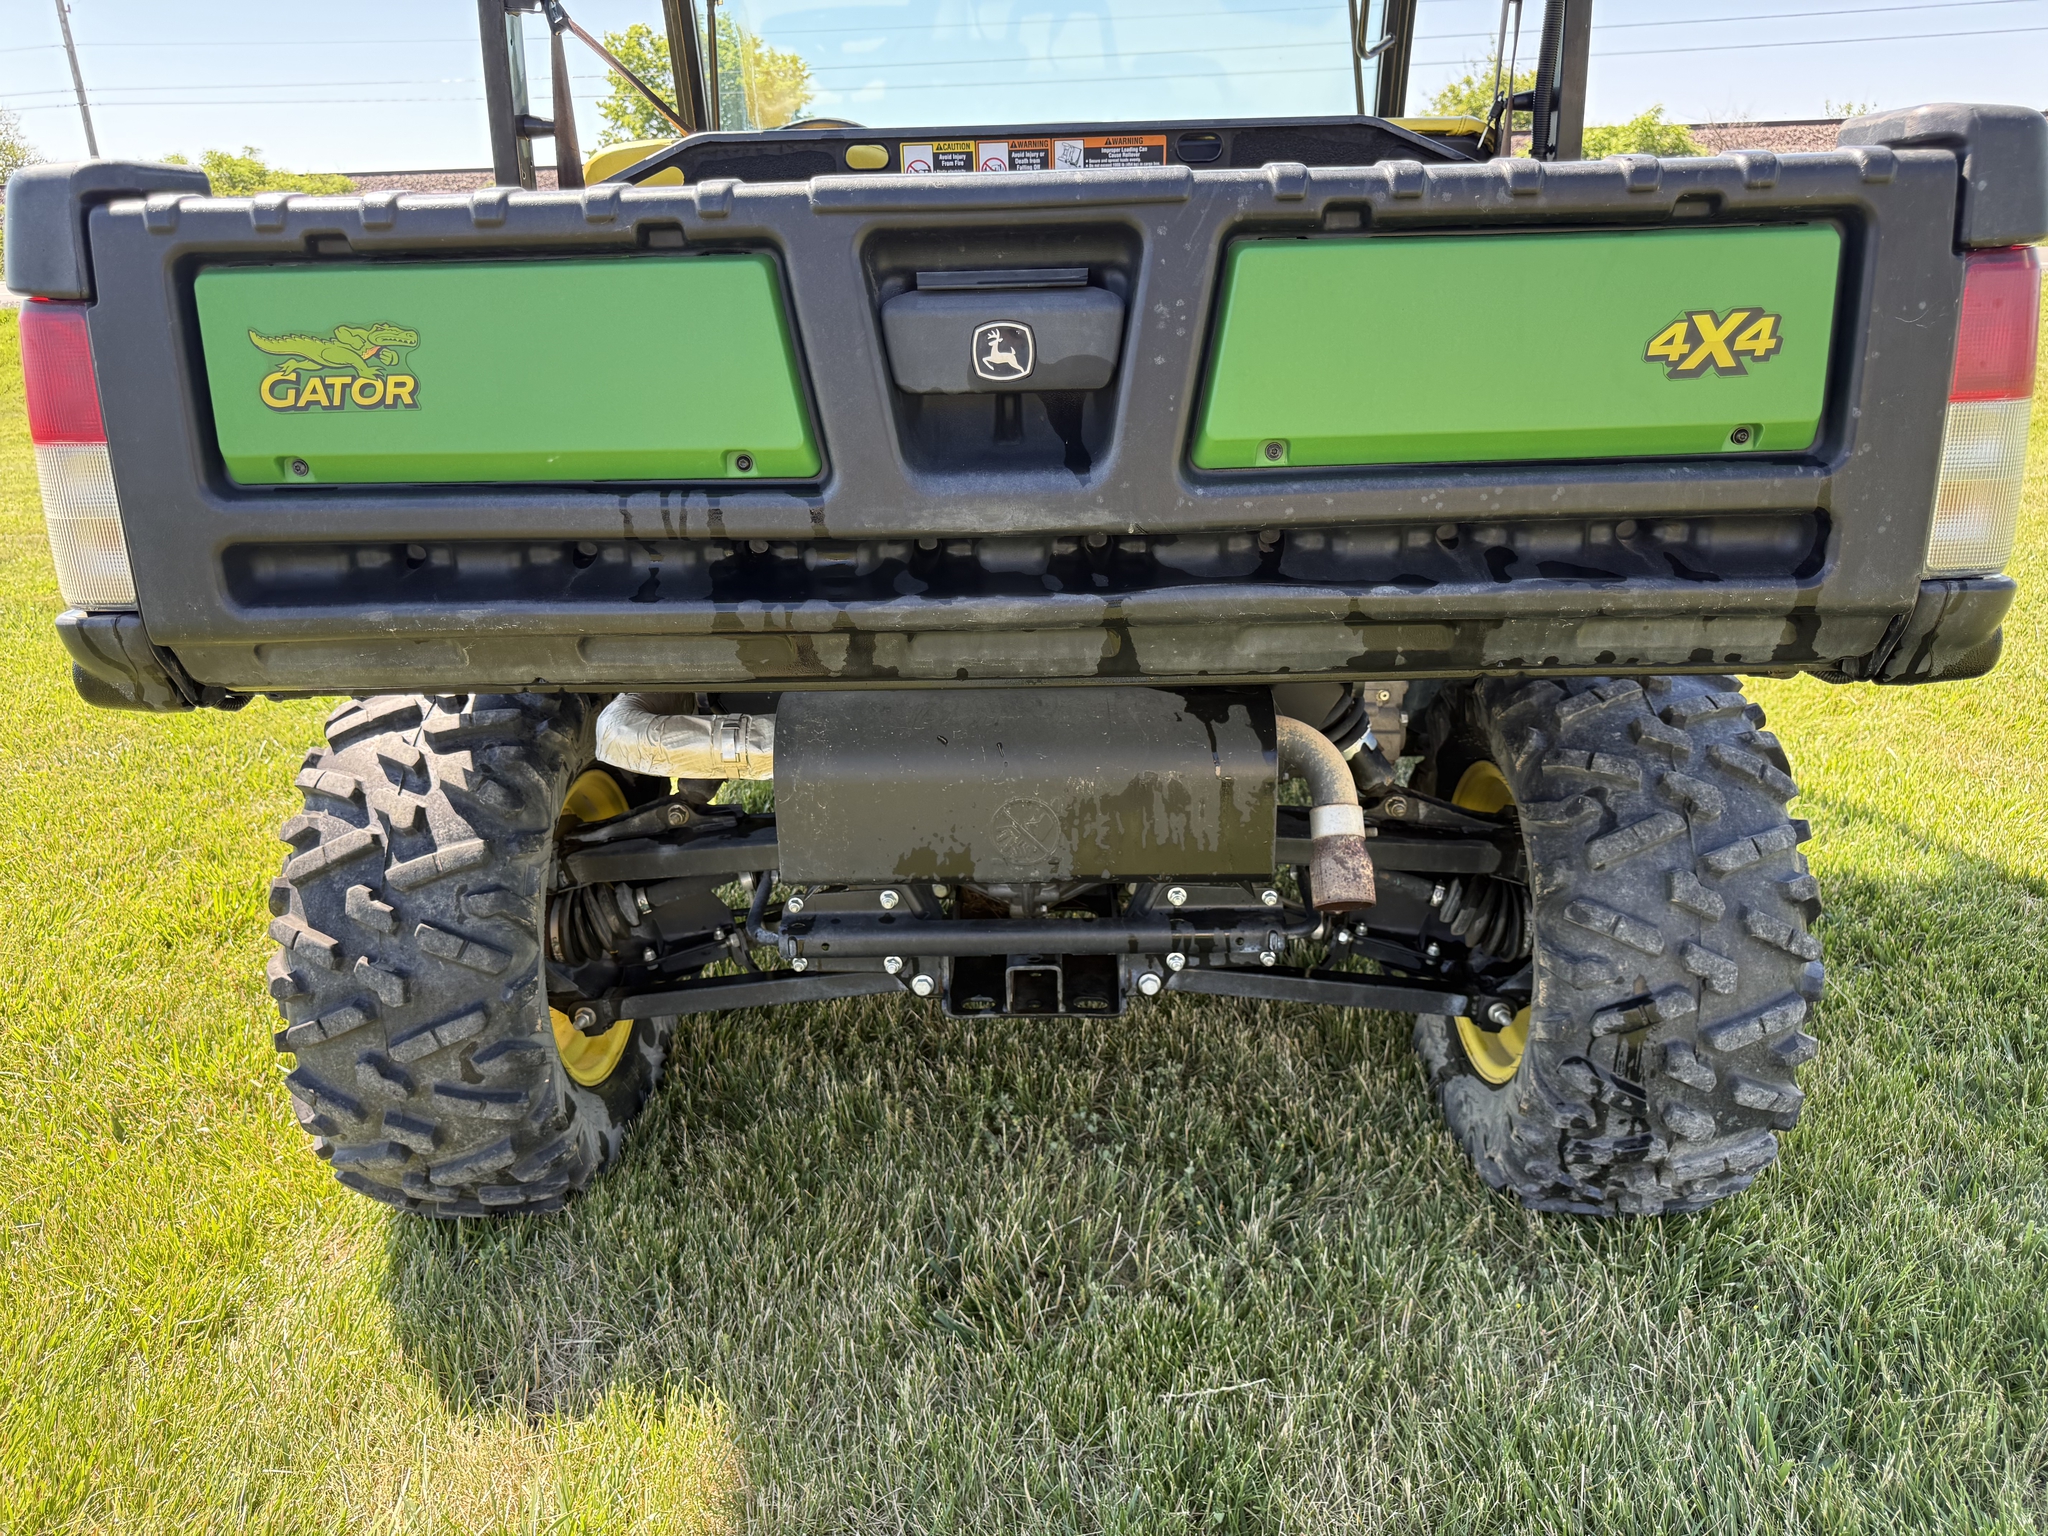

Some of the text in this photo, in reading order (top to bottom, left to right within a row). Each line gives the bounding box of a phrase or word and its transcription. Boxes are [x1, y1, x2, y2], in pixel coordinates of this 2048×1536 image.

[1018, 140, 1049, 149] WARNING
[1112, 136, 1143, 145] WARNING
[943, 142, 971, 151] CAUTION
[260, 371, 419, 412] GATOR
